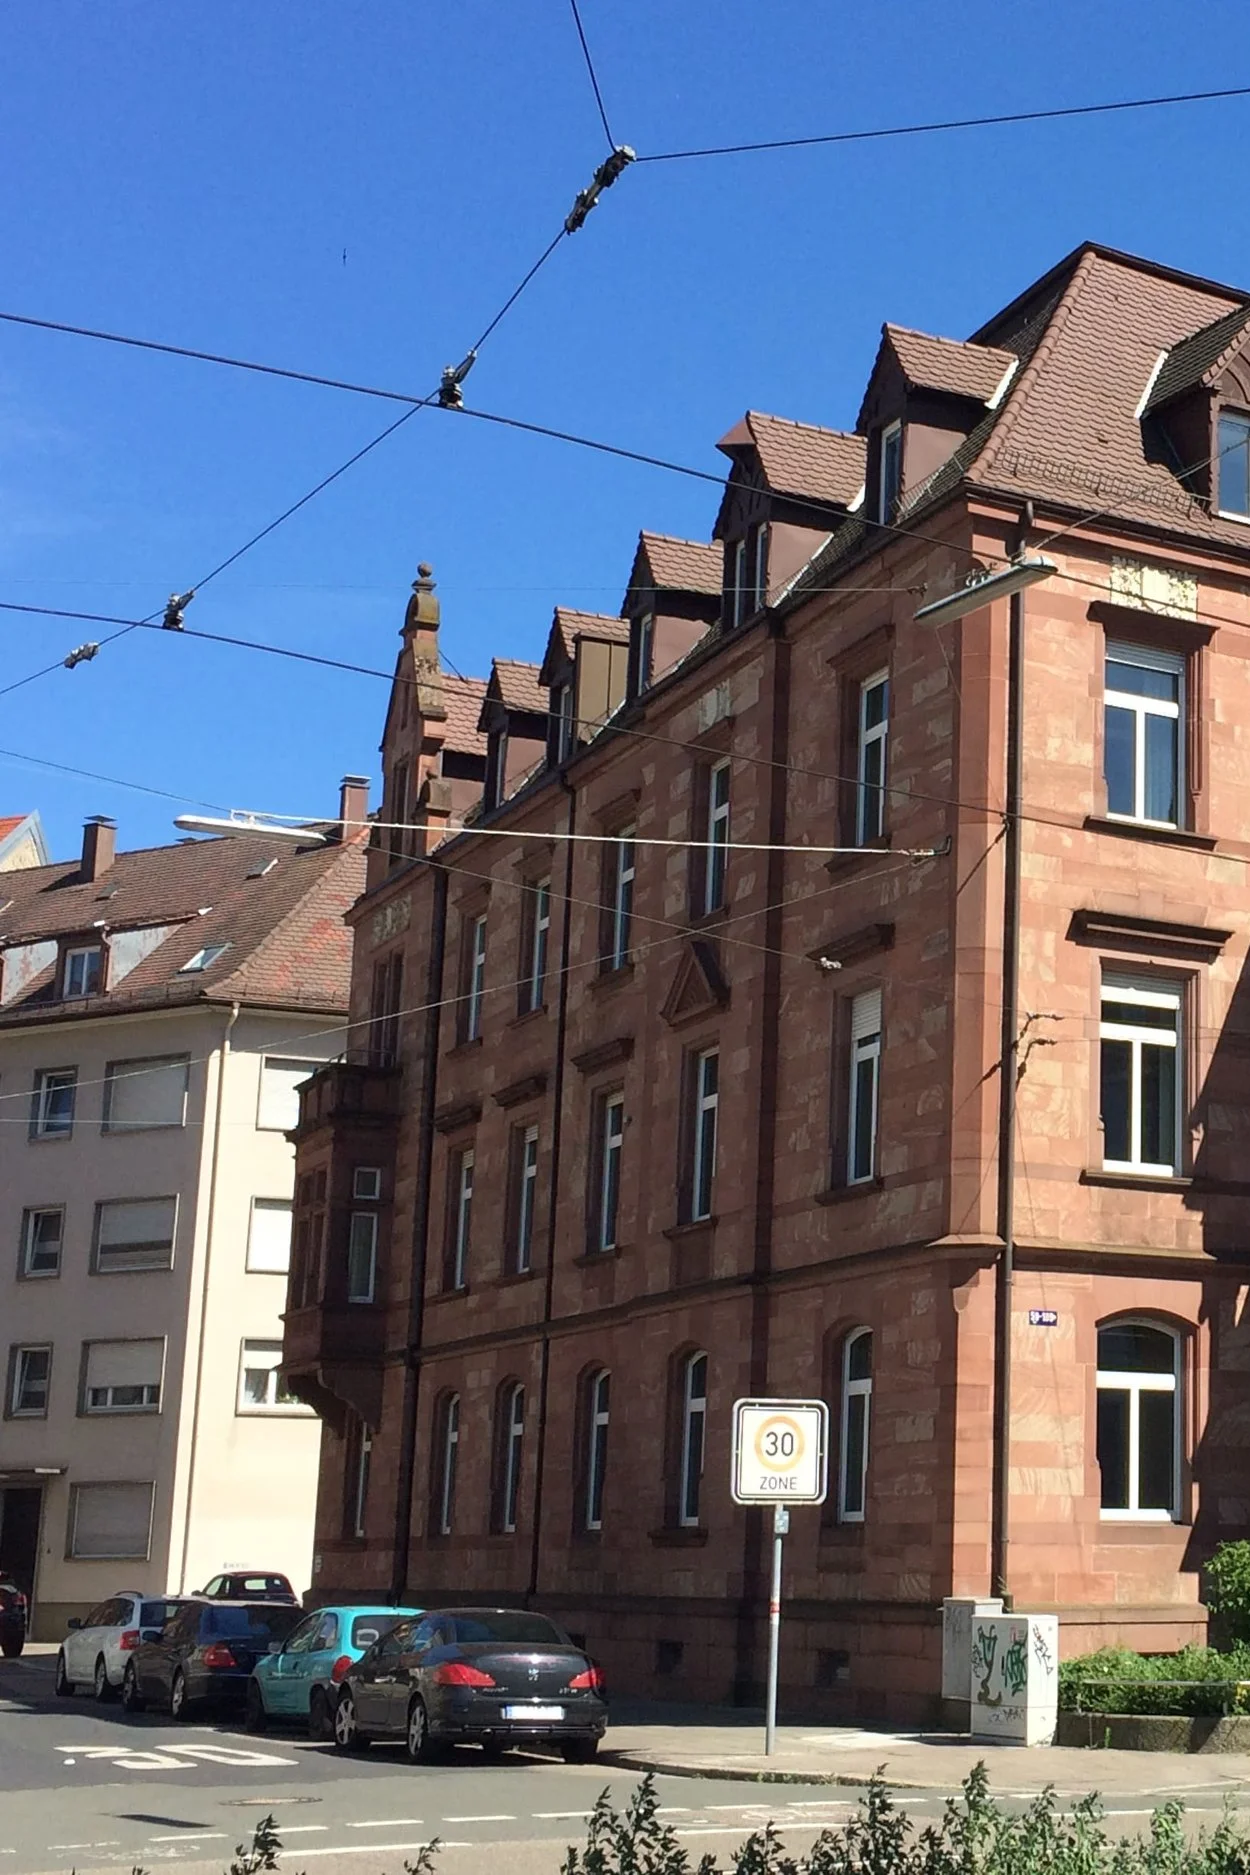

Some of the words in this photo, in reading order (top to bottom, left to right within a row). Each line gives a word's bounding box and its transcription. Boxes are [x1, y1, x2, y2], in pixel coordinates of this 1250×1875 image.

[765, 1431, 794, 1457] 30
[759, 1476, 798, 1490] ZONE
[53, 1744, 300, 1770] 30
